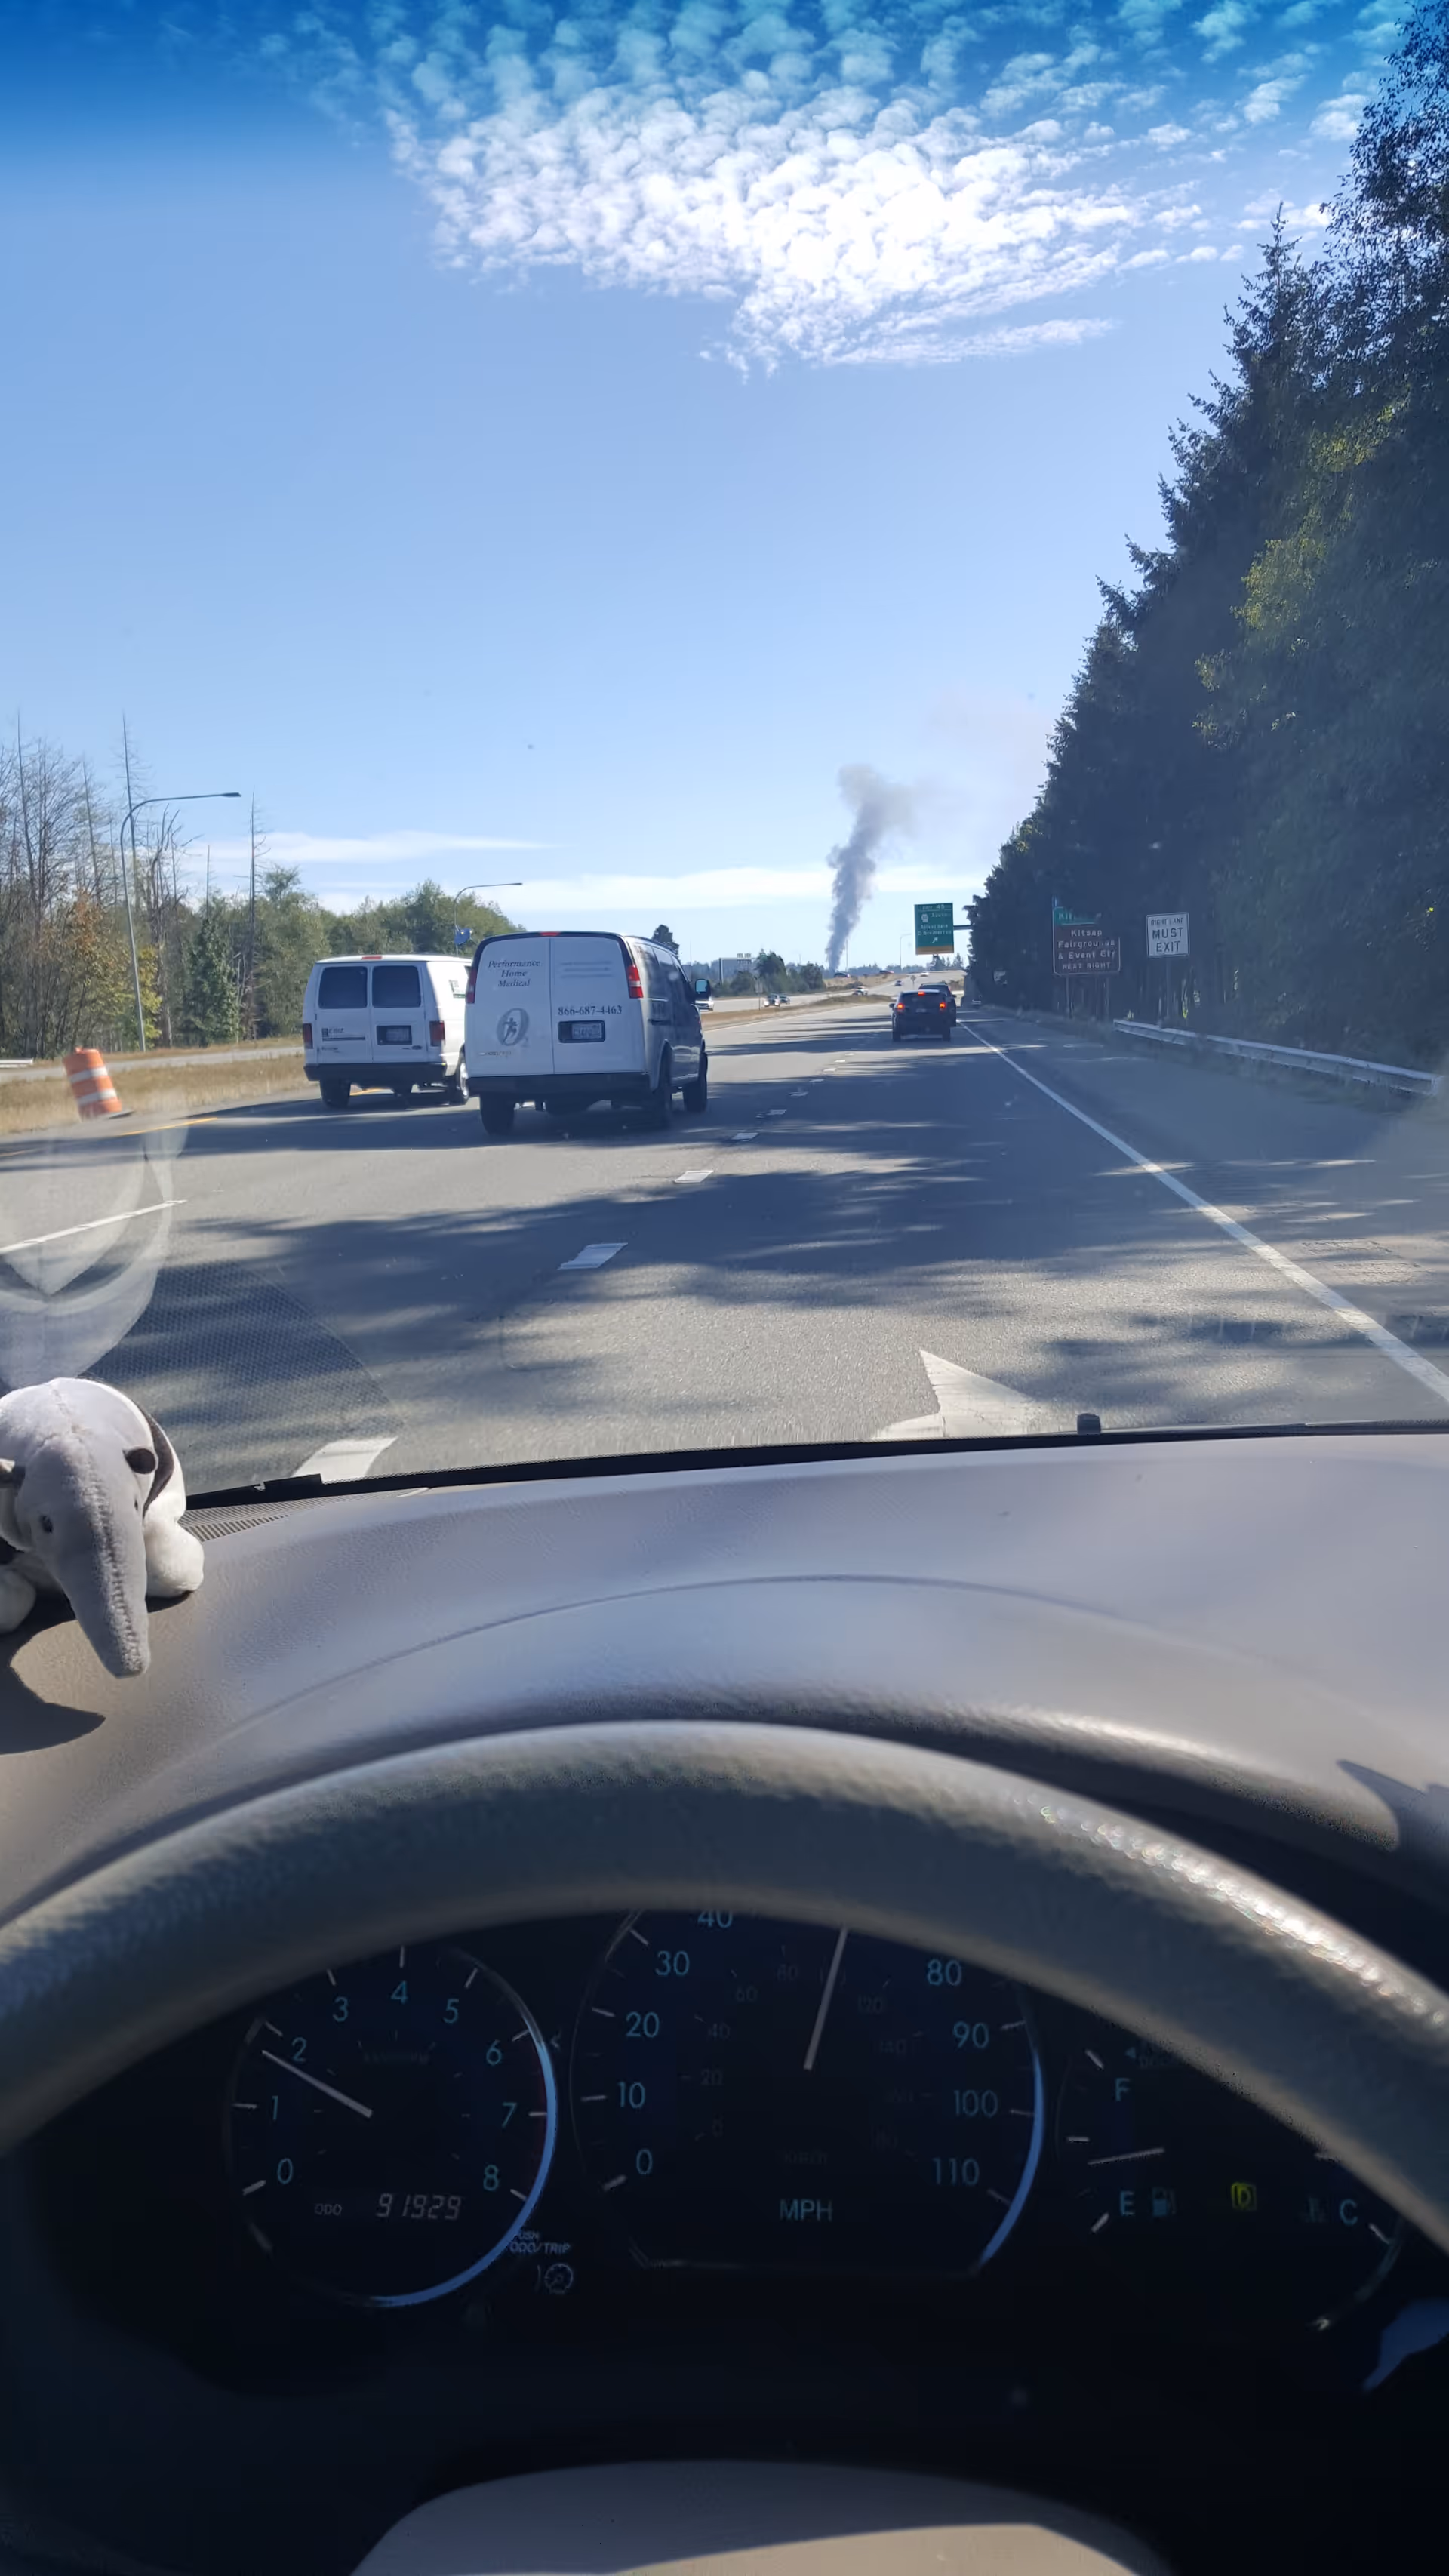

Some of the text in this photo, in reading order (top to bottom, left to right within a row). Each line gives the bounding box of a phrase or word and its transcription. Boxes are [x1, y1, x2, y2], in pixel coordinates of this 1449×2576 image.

[1152, 927, 1184, 940] MUST
[1156, 940, 1181, 953] EXIT
[488, 959, 542, 968] Performance
[1068, 951, 1096, 959] Event
[498, 978, 531, 987] Medical
[501, 969, 527, 978] Home
[558, 1005, 623, 1016] 866-687-4463
[655, 1950, 691, 1976] 30
[926, 1959, 963, 1986] 80
[390, 1980, 409, 2005] 4
[332, 1996, 349, 2022] 3
[443, 1998, 460, 2024] 5
[626, 2011, 660, 2038] 20
[952, 2020, 989, 2048] 90
[291, 2037, 307, 2063] 2
[485, 2039, 503, 2066] 6
[618, 2081, 646, 2109] 10
[1115, 2077, 1131, 2102] F
[272, 2095, 278, 2121] 1
[501, 2101, 518, 2128] 7
[953, 2089, 998, 2118] 100
[276, 2157, 294, 2185] 0
[635, 2148, 654, 2176] 0
[932, 2157, 980, 2186] 110
[482, 2164, 500, 2192] 8
[314, 2193, 462, 2221] ODO 91929
[1119, 2190, 1135, 2217] E
[1237, 2184, 1251, 2207] D
[780, 2198, 832, 2221] MPH
[1339, 2199, 1358, 2226] C
[509, 2241, 571, 2254] ODO/TRIP
